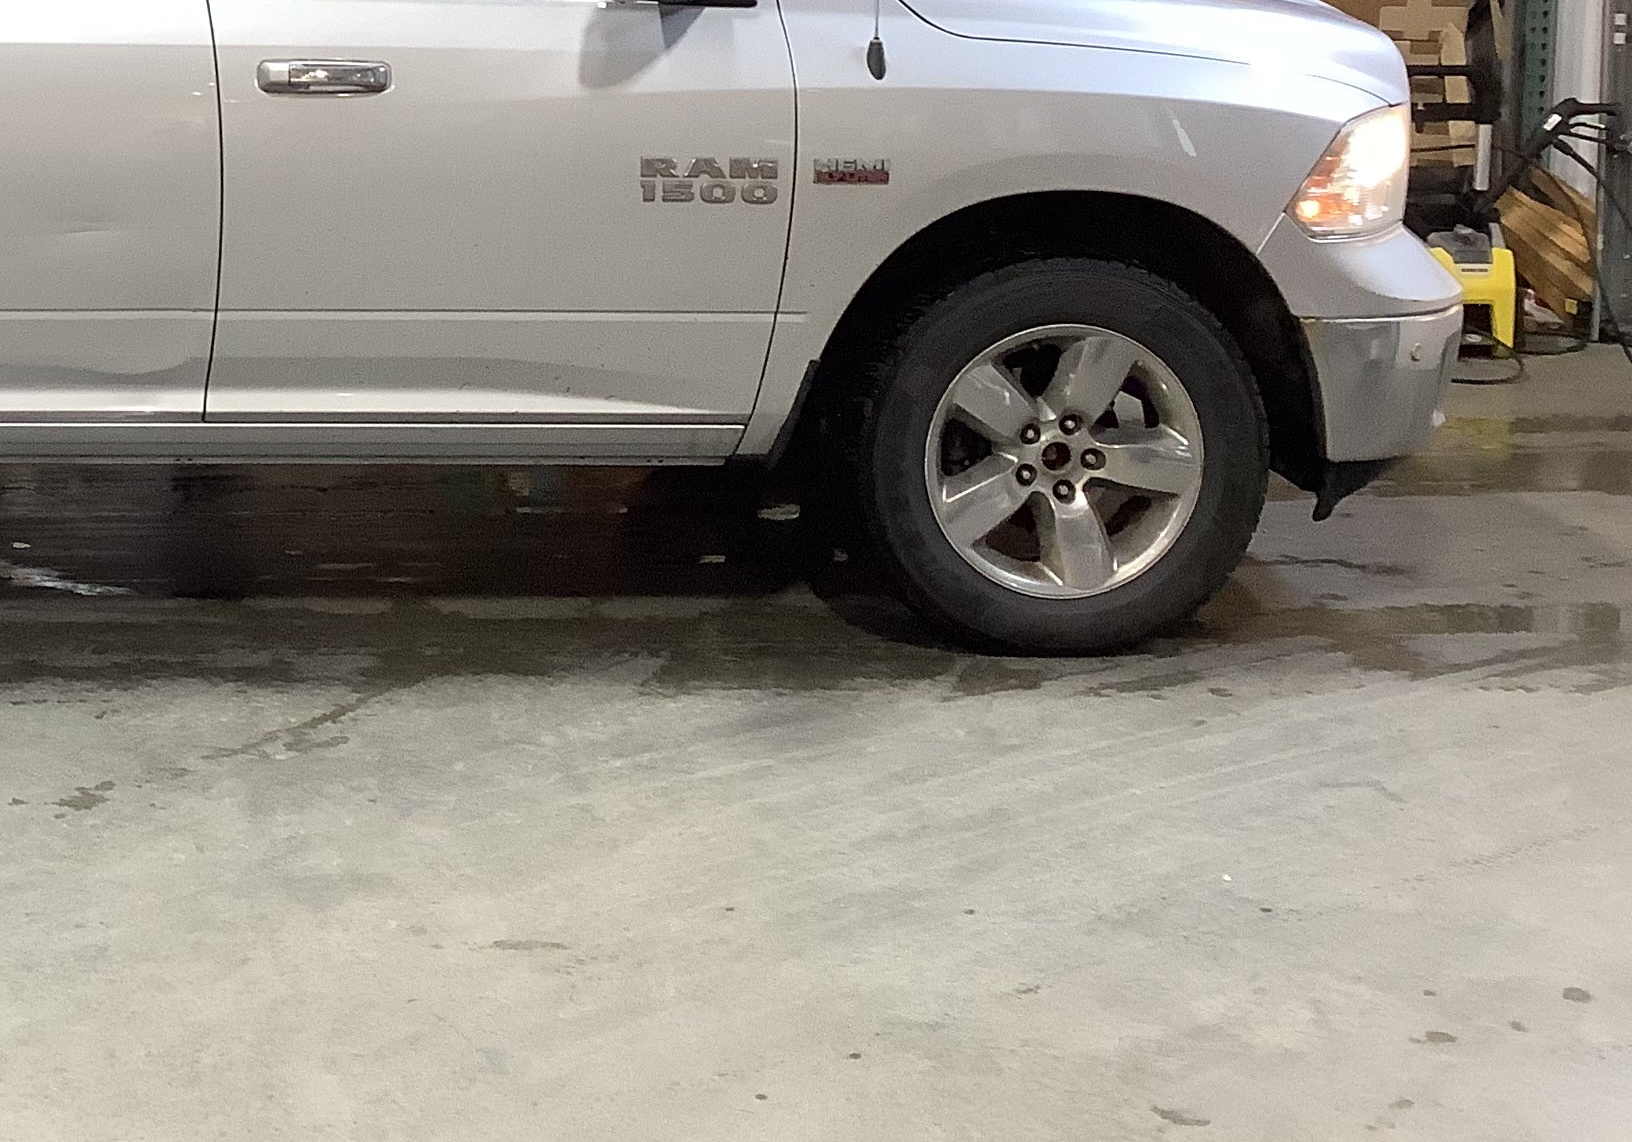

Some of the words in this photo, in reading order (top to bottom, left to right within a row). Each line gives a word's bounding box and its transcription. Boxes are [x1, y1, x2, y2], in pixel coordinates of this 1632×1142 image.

[640, 156, 778, 179] RAM
[813, 158, 891, 172] HEMI
[640, 179, 778, 204] 1500
